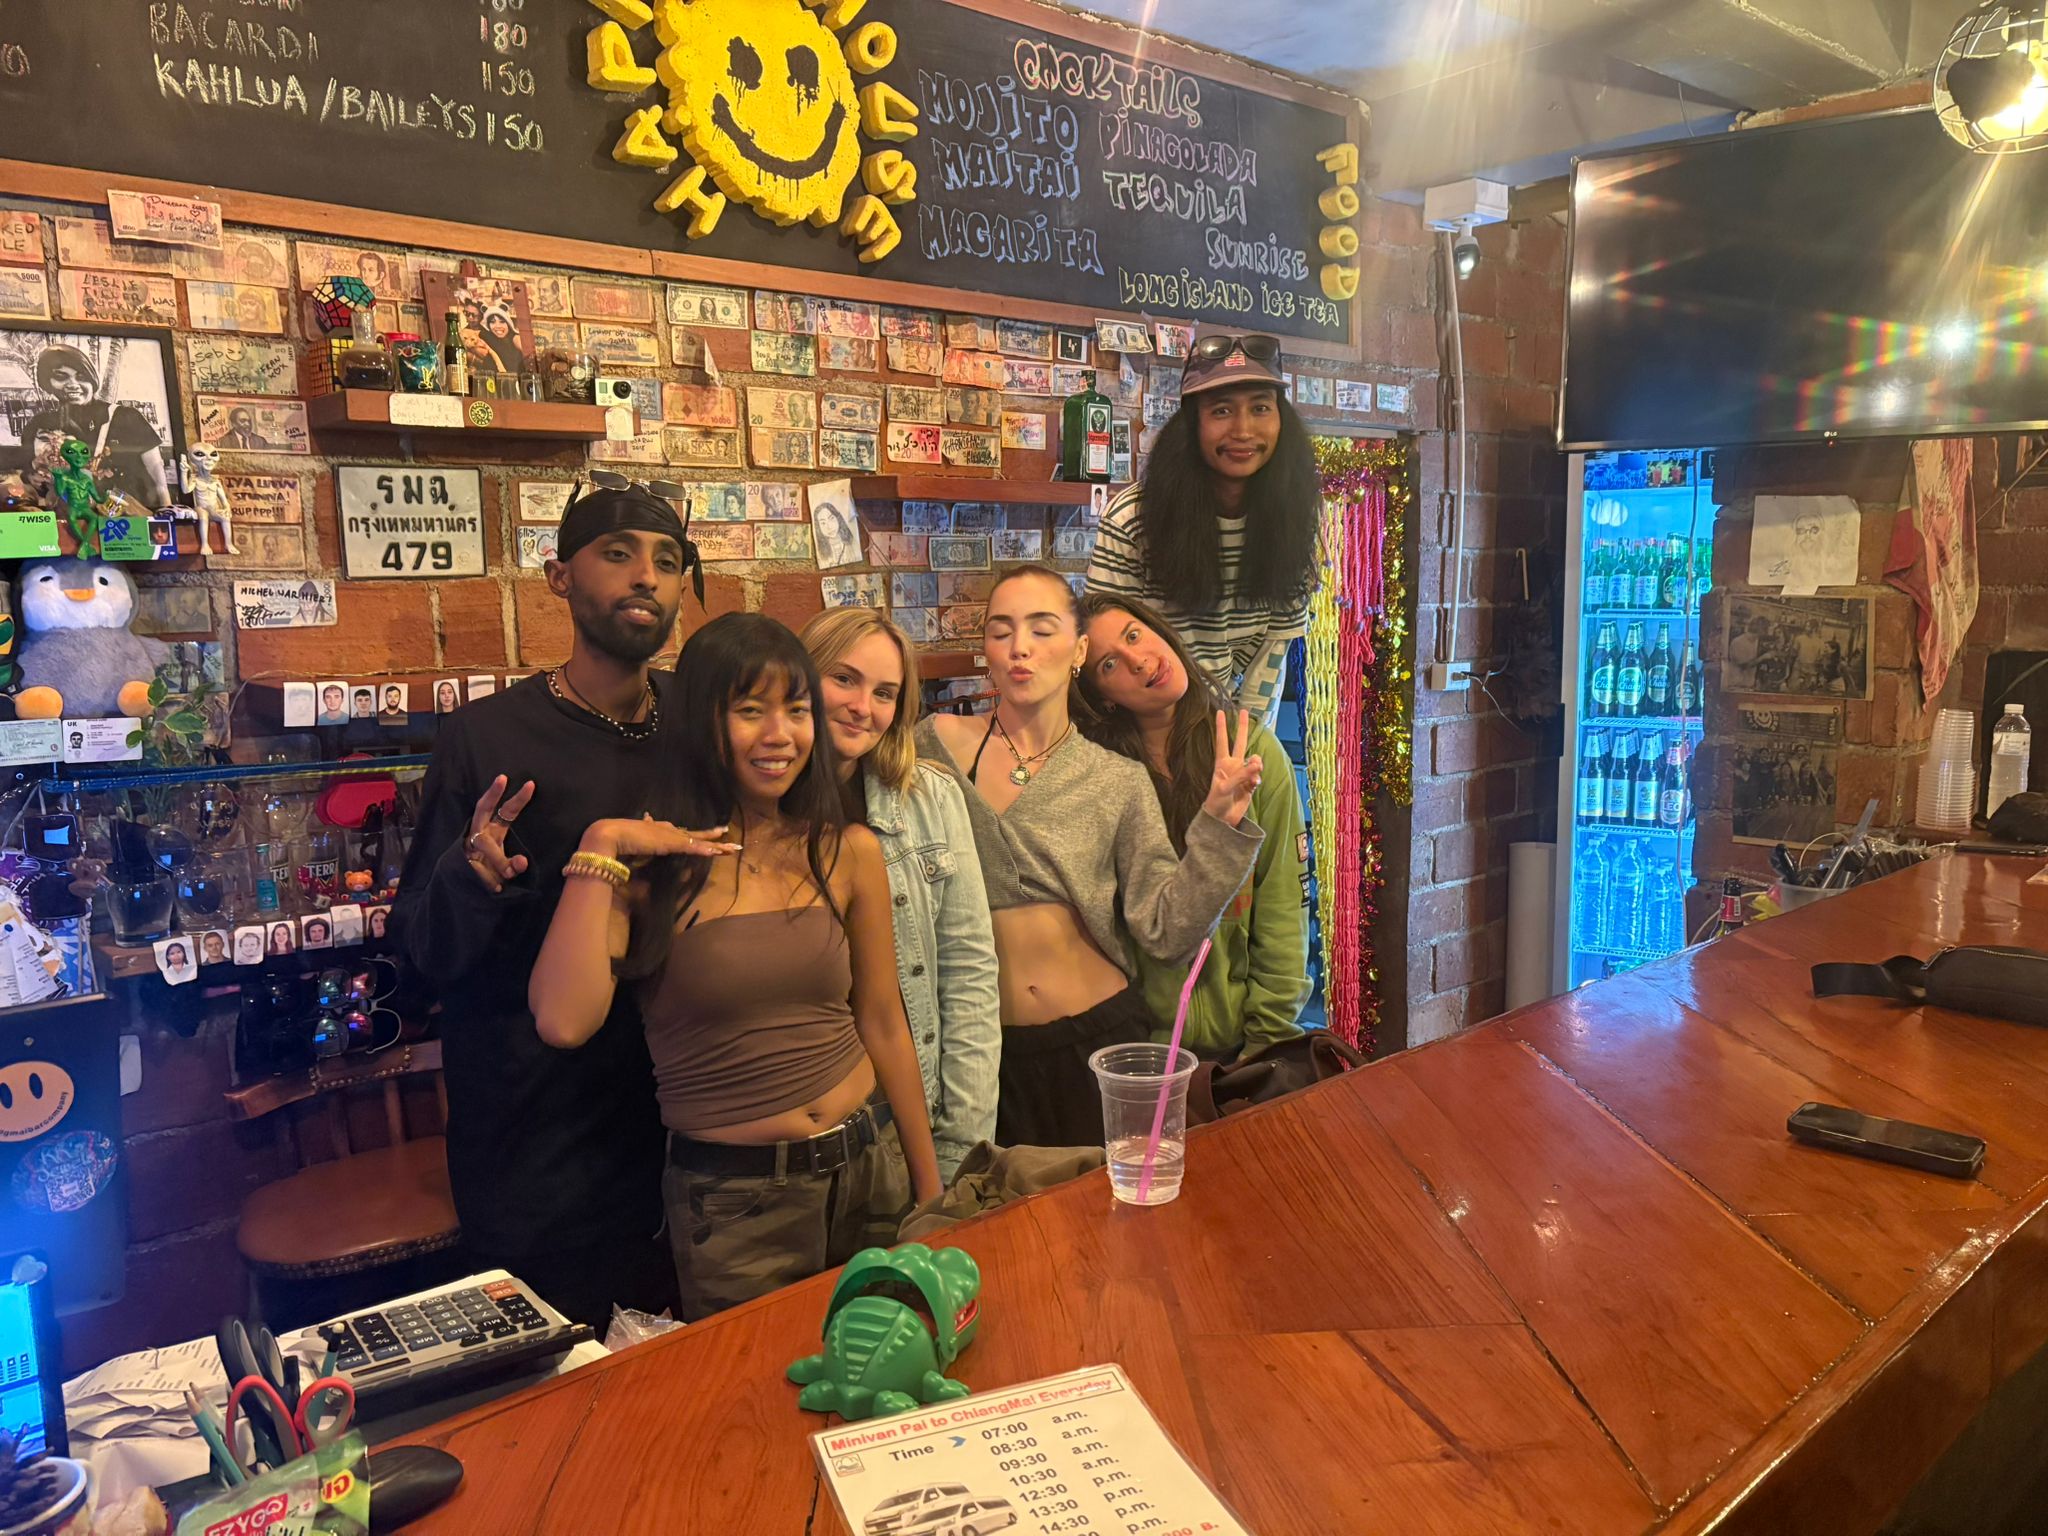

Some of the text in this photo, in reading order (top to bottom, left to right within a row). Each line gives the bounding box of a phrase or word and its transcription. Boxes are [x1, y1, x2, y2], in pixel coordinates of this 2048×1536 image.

[153, 52, 307, 115] KAHLUA
[487, 112, 544, 151] 150
[1299, 297, 1340, 328] TEA
[752, 414, 763, 425] 20
[901, 447, 912, 459] 20
[747, 484, 760, 496] 20
[348, 516, 478, 539] กรุงเทพมหานคร
[381, 541, 453, 571] 479
[830, 1426, 897, 1452] Minivan
[901, 1420, 929, 1436] Pai
[931, 1416, 948, 1428] to
[1039, 1377, 1113, 1404] Everyday
[889, 1409, 1089, 1462] Time 07:00 a.m.
[989, 1426, 1099, 1457] 08:30 a.m.
[999, 1440, 1109, 1472] 09:30 a.m.
[1009, 1455, 1120, 1488] 10:30 a.m.
[1019, 1470, 1132, 1503] 12:30 p.m.
[1028, 1485, 1144, 1519] 13:30 p.m.
[1039, 1500, 1156, 1536] 14:30 p.m.
[1126, 1516, 1168, 1535] p.m.
